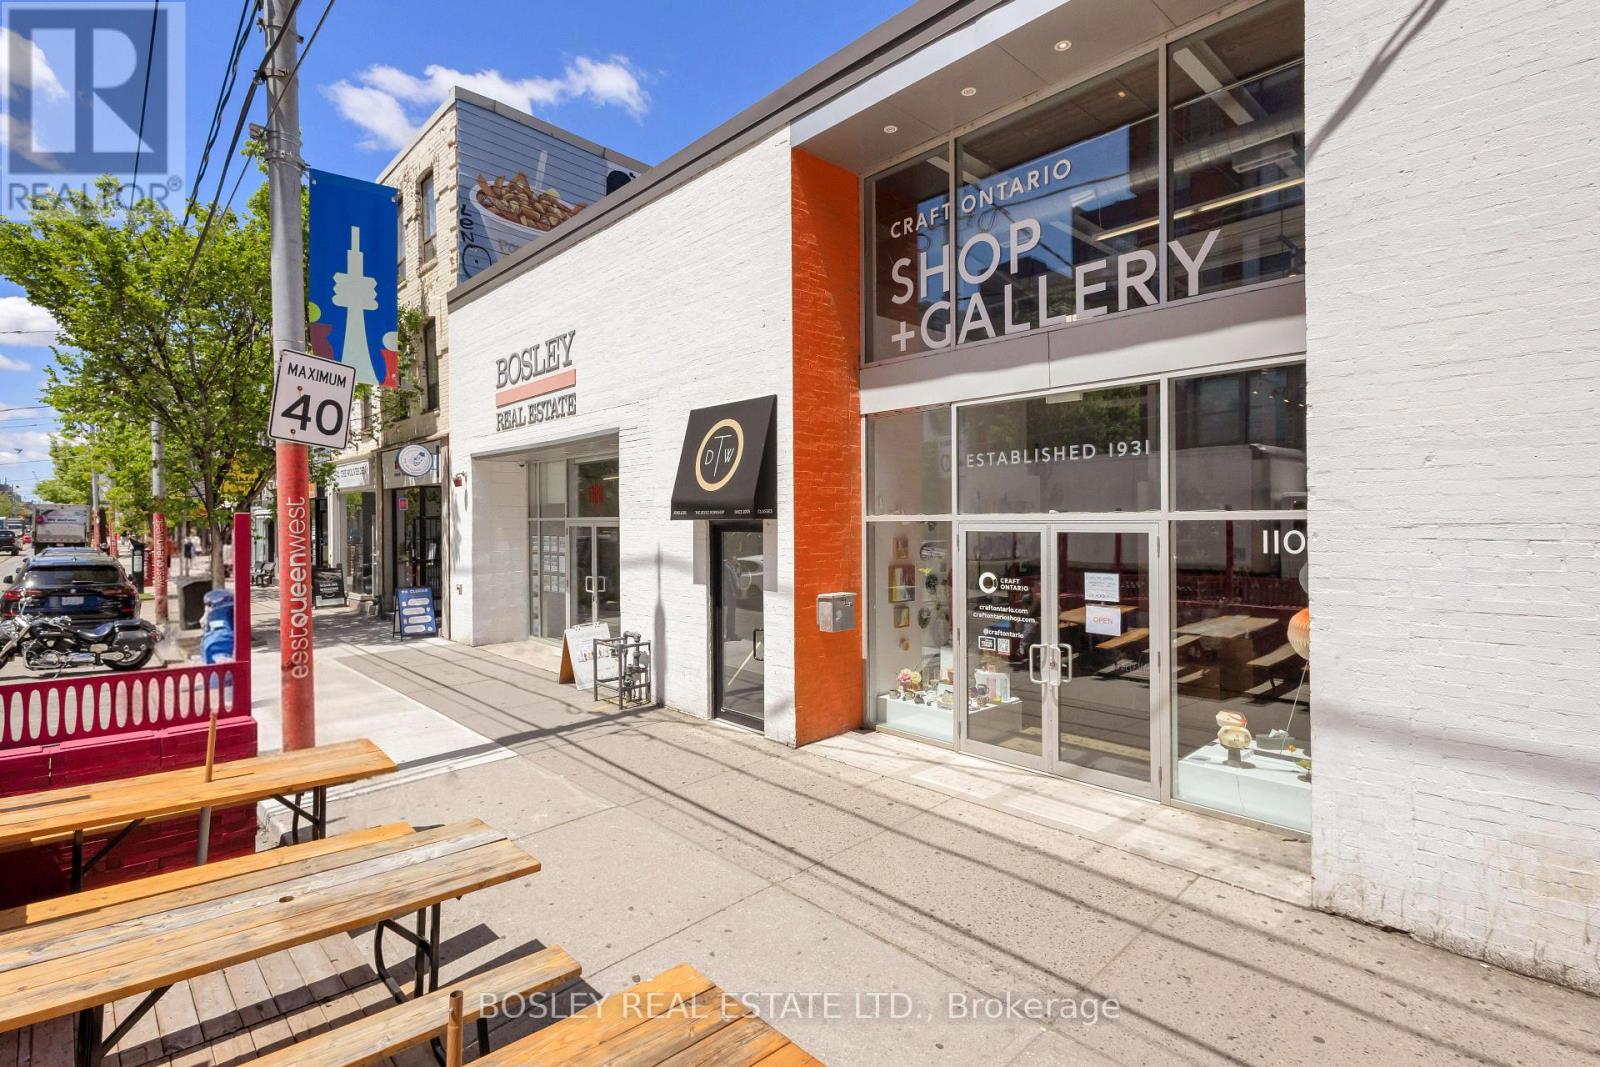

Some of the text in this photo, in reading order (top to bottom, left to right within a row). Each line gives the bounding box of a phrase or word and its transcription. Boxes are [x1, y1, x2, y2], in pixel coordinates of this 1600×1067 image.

[890, 159, 1072, 239] CRAFT ONTARIO
[891, 217, 1042, 305] SHOP
[496, 329, 576, 389] BOSLEY
[287, 361, 347, 389] MAXIMUM
[280, 393, 344, 437] 40
[496, 392, 577, 431] REAL ESTATE
[966, 439, 1150, 468] ESTABLISHED 1931
[1000, 577, 1020, 585] CRAFT
[1000, 584, 1029, 592] ONTARIO
[972, 612, 1036, 624] craftontarioshop.com
[979, 604, 1029, 615] craftontario.com
[1092, 616, 1114, 625] OPEN
[983, 628, 1025, 639] @craftontario
